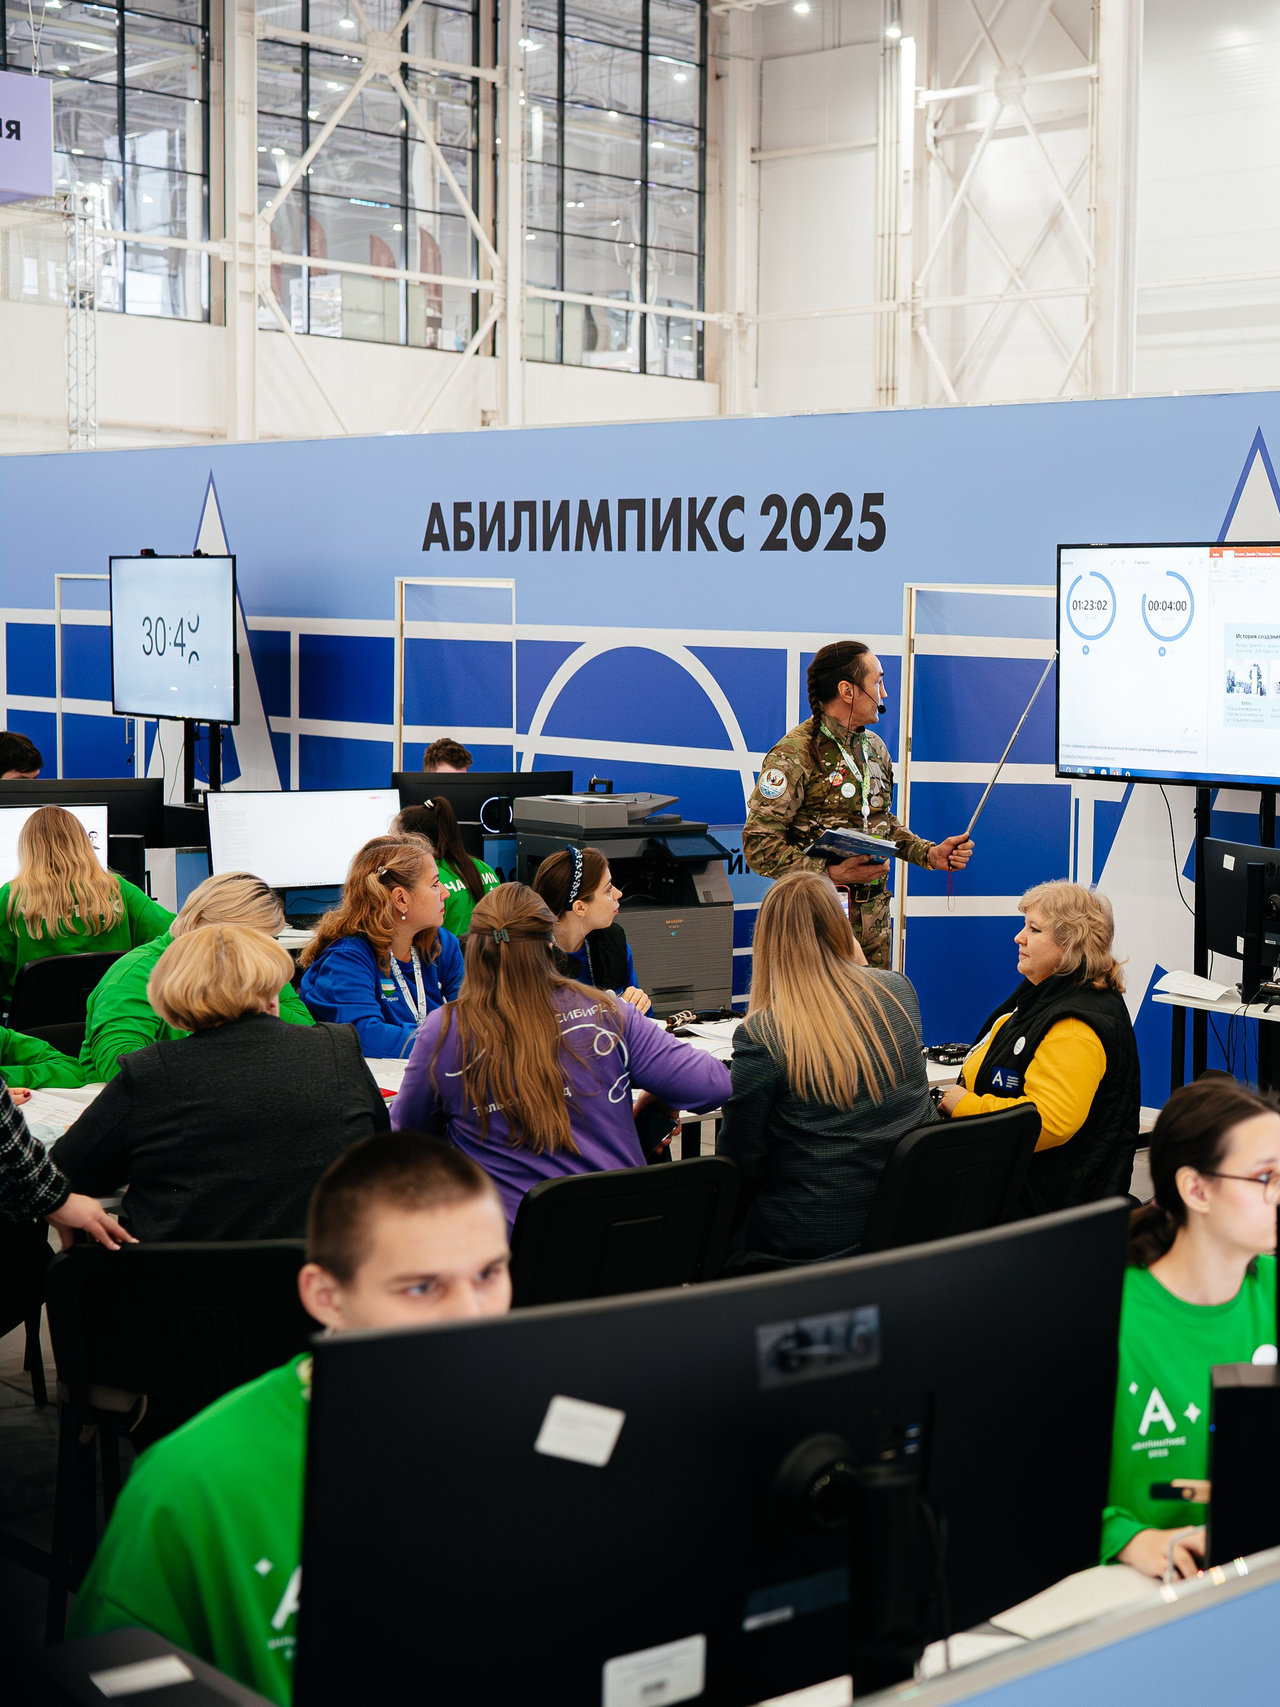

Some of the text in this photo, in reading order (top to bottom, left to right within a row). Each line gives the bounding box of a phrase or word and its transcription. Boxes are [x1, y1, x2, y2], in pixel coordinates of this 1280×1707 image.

[0, 117, 22, 141] Я
[422, 492, 887, 553] АБИЛИМПИКС 2025
[1072, 600, 1108, 611] 01:23:02
[1147, 600, 1187, 612] 00:04:00
